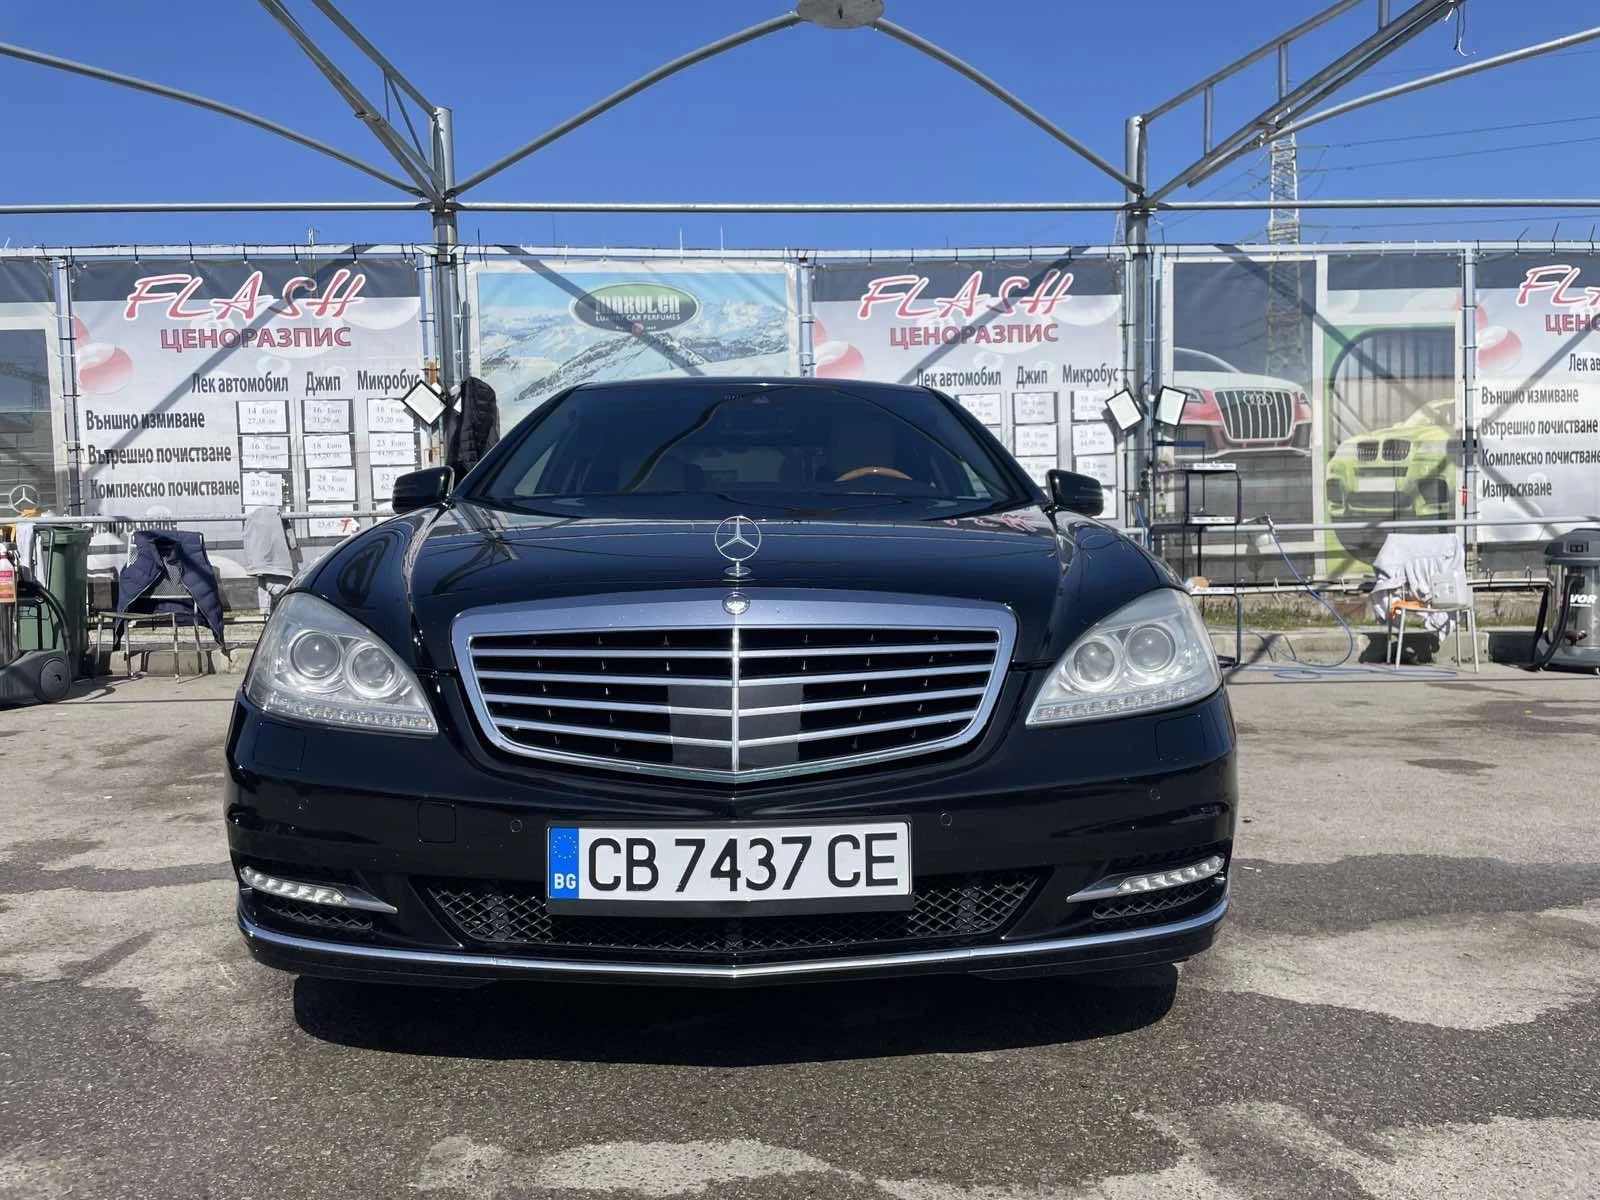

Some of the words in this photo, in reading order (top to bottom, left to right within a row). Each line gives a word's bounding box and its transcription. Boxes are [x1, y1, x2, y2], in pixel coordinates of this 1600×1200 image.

[125, 269, 366, 320] FLASH
[857, 268, 1074, 320] FLASH
[160, 326, 352, 352] ЦЕНОРАЗПИС
[889, 323, 1059, 350] ЦЕНОРАЗПИС
[1569, 353, 1588, 372] Лек
[191, 372, 216, 393] Лек
[218, 371, 289, 392] автомобил
[305, 371, 341, 396] Джип
[916, 369, 937, 387] Лек
[939, 366, 1001, 387] автомобил
[1016, 366, 1048, 389] Джип
[1062, 363, 1119, 387] Микробус
[1481, 386, 1525, 405] Външно
[1527, 388, 1579, 403] измиване
[86, 410, 139, 430] Външно
[141, 412, 205, 429] измиване
[1481, 417, 1535, 440] Вътрешно
[1538, 419, 1598, 434] почистване
[88, 444, 153, 469] Вътрешно
[156, 446, 231, 463] почистване
[1482, 448, 1543, 467] Комплексно
[91, 479, 165, 499] Комплексно
[168, 480, 240, 496] почистване
[1482, 480, 1552, 502] Изпръскване
[588, 837, 660, 892] CB
[674, 836, 812, 892] 7437
[827, 832, 899, 888] CE
[553, 873, 577, 890] BG
